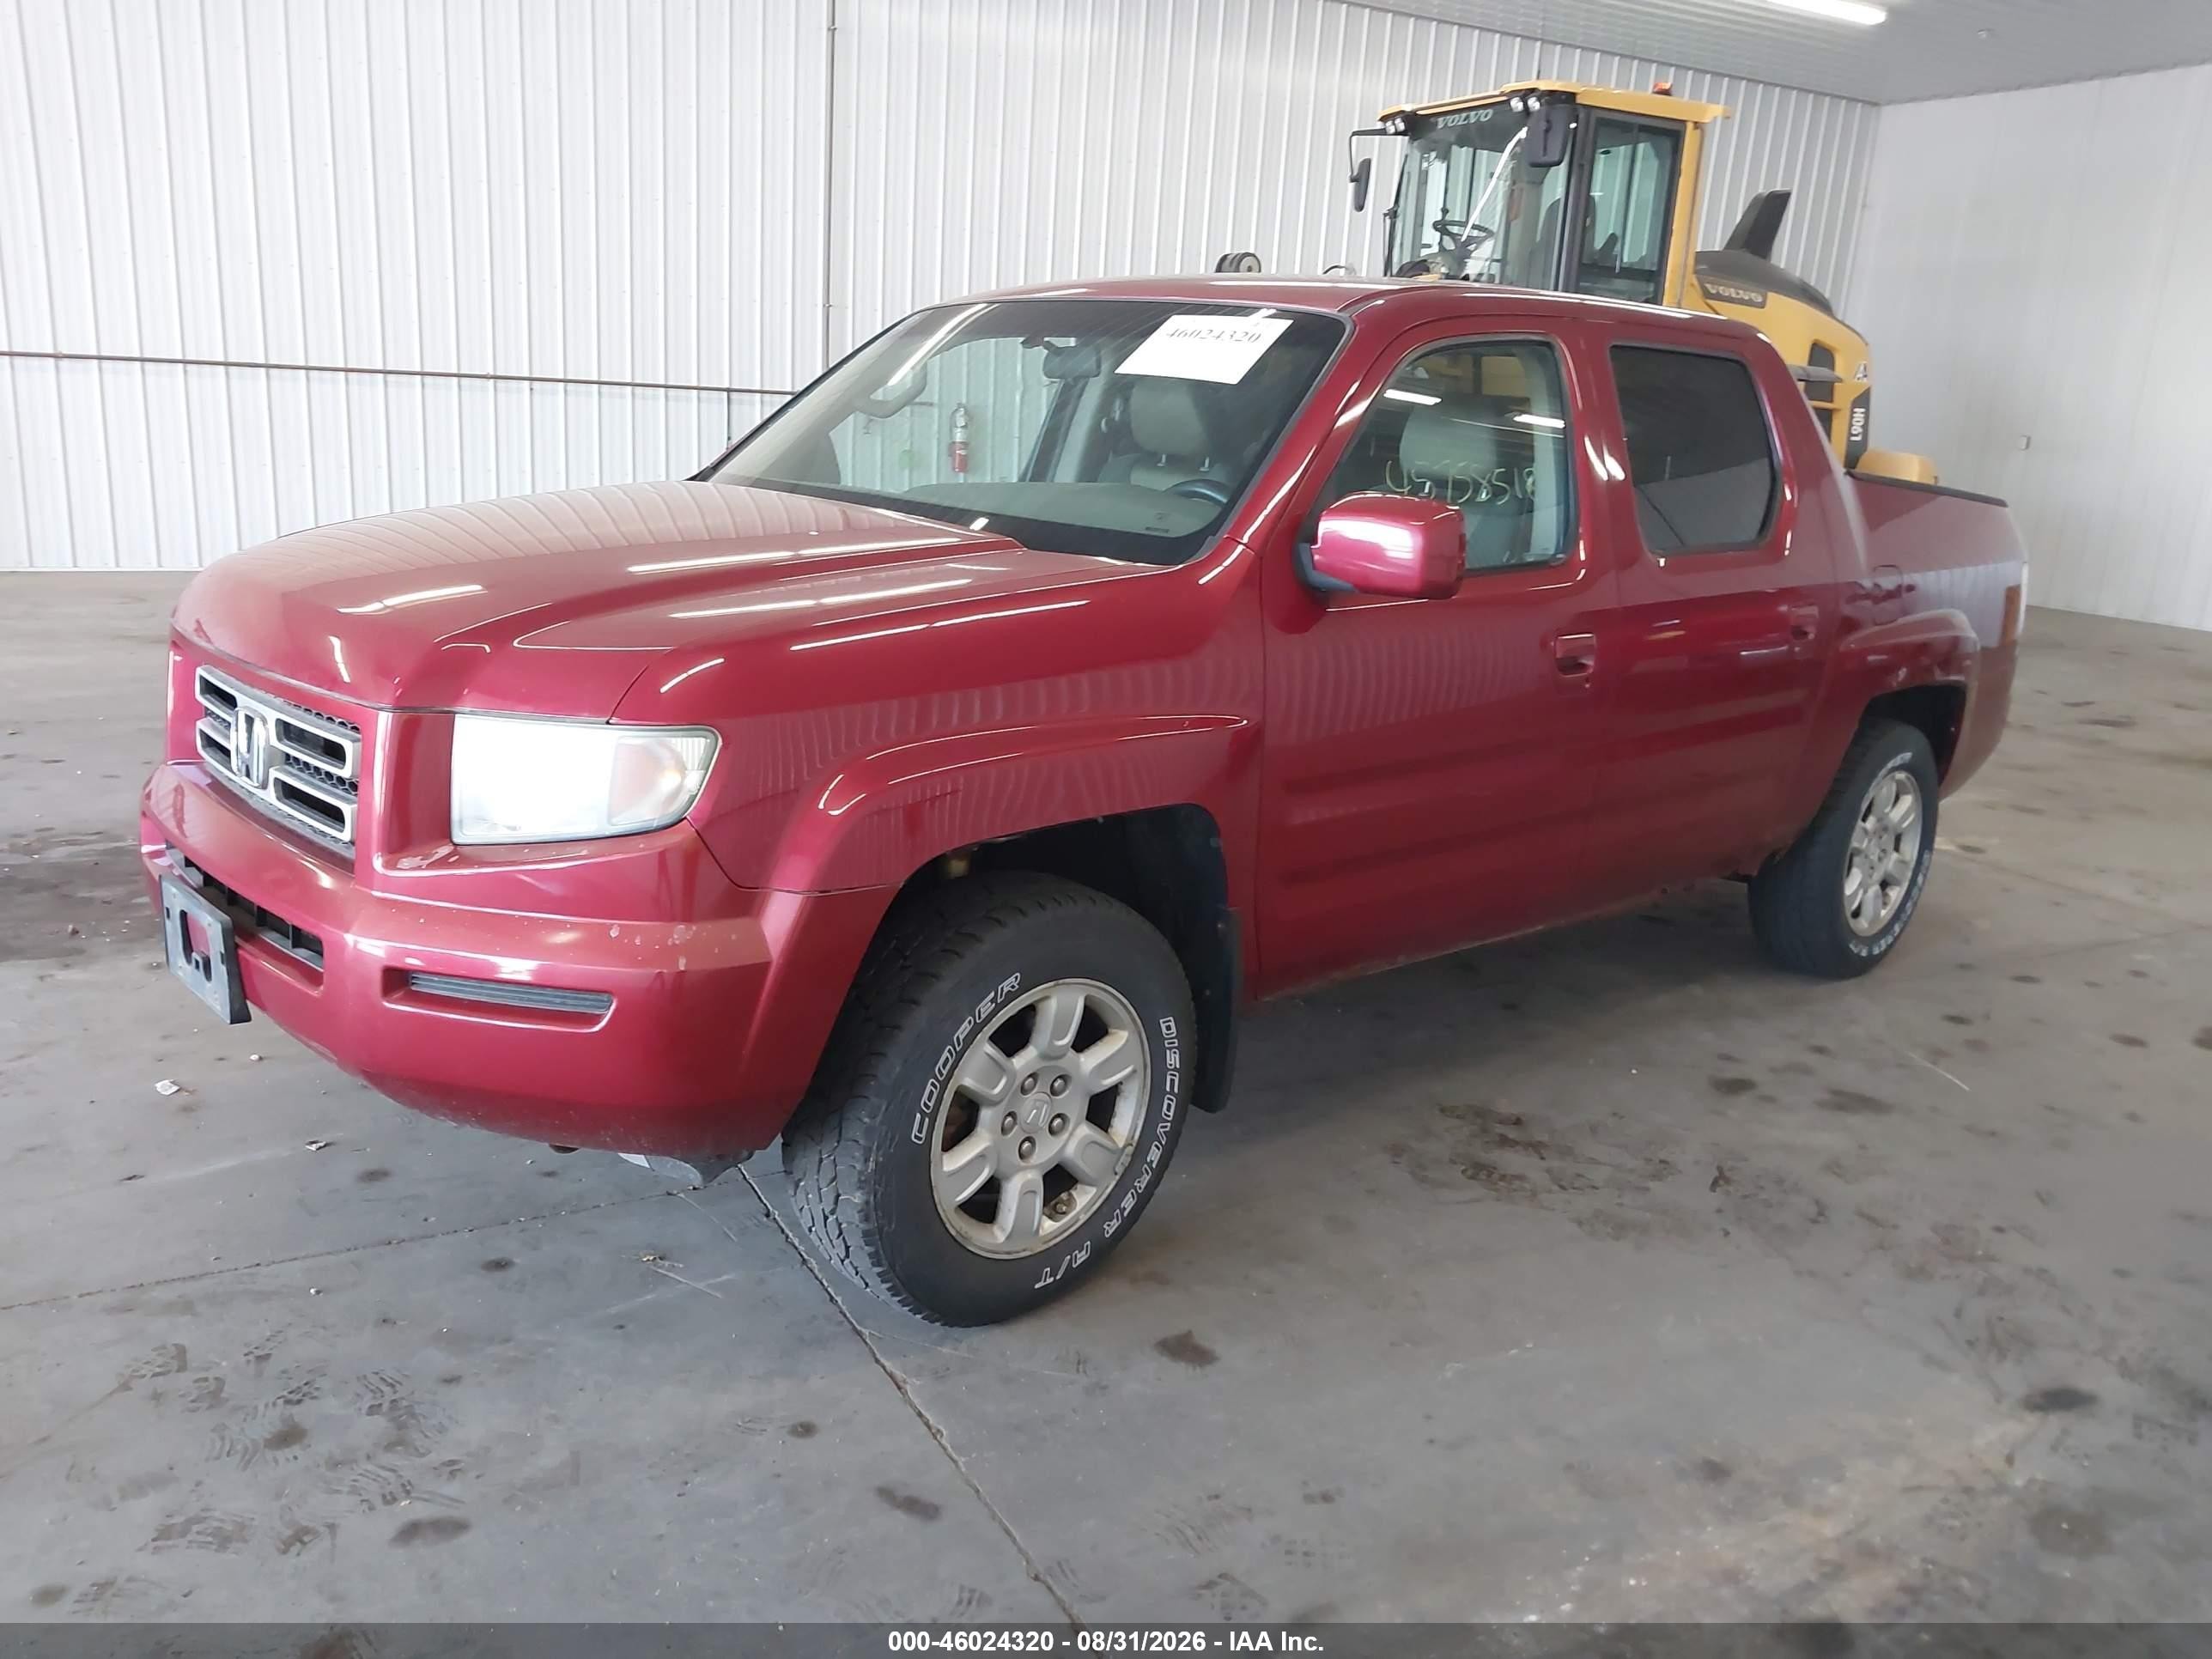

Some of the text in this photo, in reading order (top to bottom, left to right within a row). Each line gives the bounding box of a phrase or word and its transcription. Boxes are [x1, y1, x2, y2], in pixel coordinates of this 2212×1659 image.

[1437, 108, 1493, 129] VOLVO
[1704, 283, 1763, 302] VOLVO
[1165, 327, 1262, 343] 46024320
[1849, 407, 1867, 441] L90H
[911, 971, 1023, 1145] COOPER
[1034, 1016, 1182, 1289] DISCOVERER A/T
